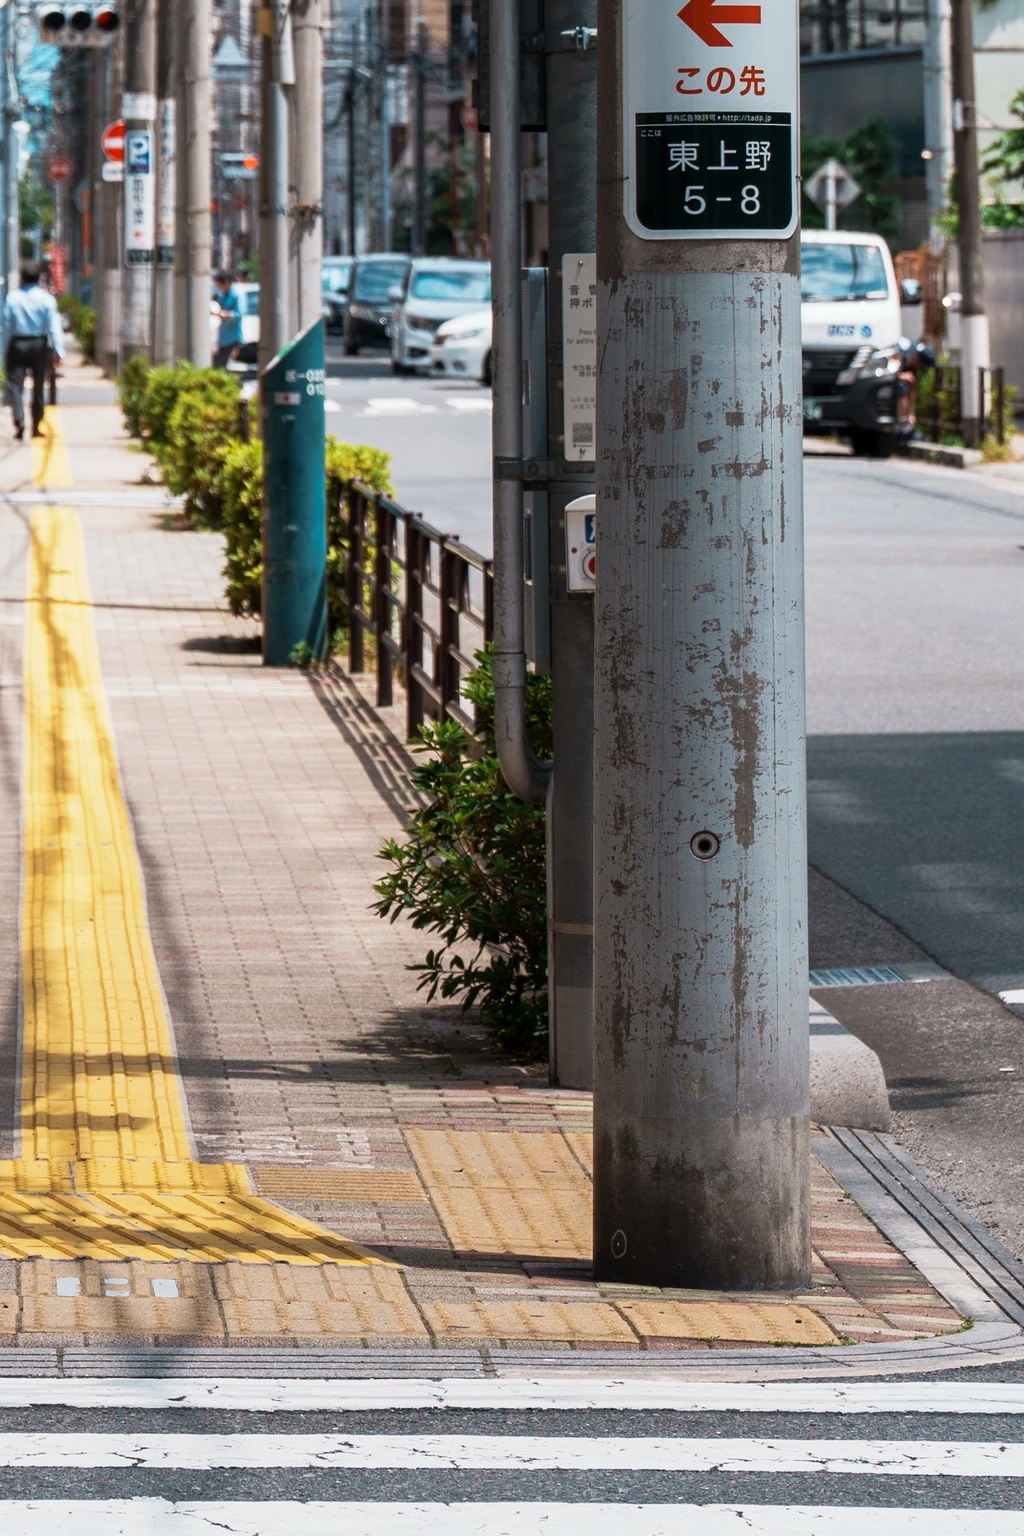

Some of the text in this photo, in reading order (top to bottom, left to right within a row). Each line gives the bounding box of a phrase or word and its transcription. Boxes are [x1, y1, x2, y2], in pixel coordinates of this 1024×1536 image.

[675, 65, 766, 97] この先
[640, 129, 662, 138] ここは
[722, 114, 772, 123] http://tadp.jp
[667, 140, 772, 172] 東上野
[682, 184, 762, 215] 5-8
